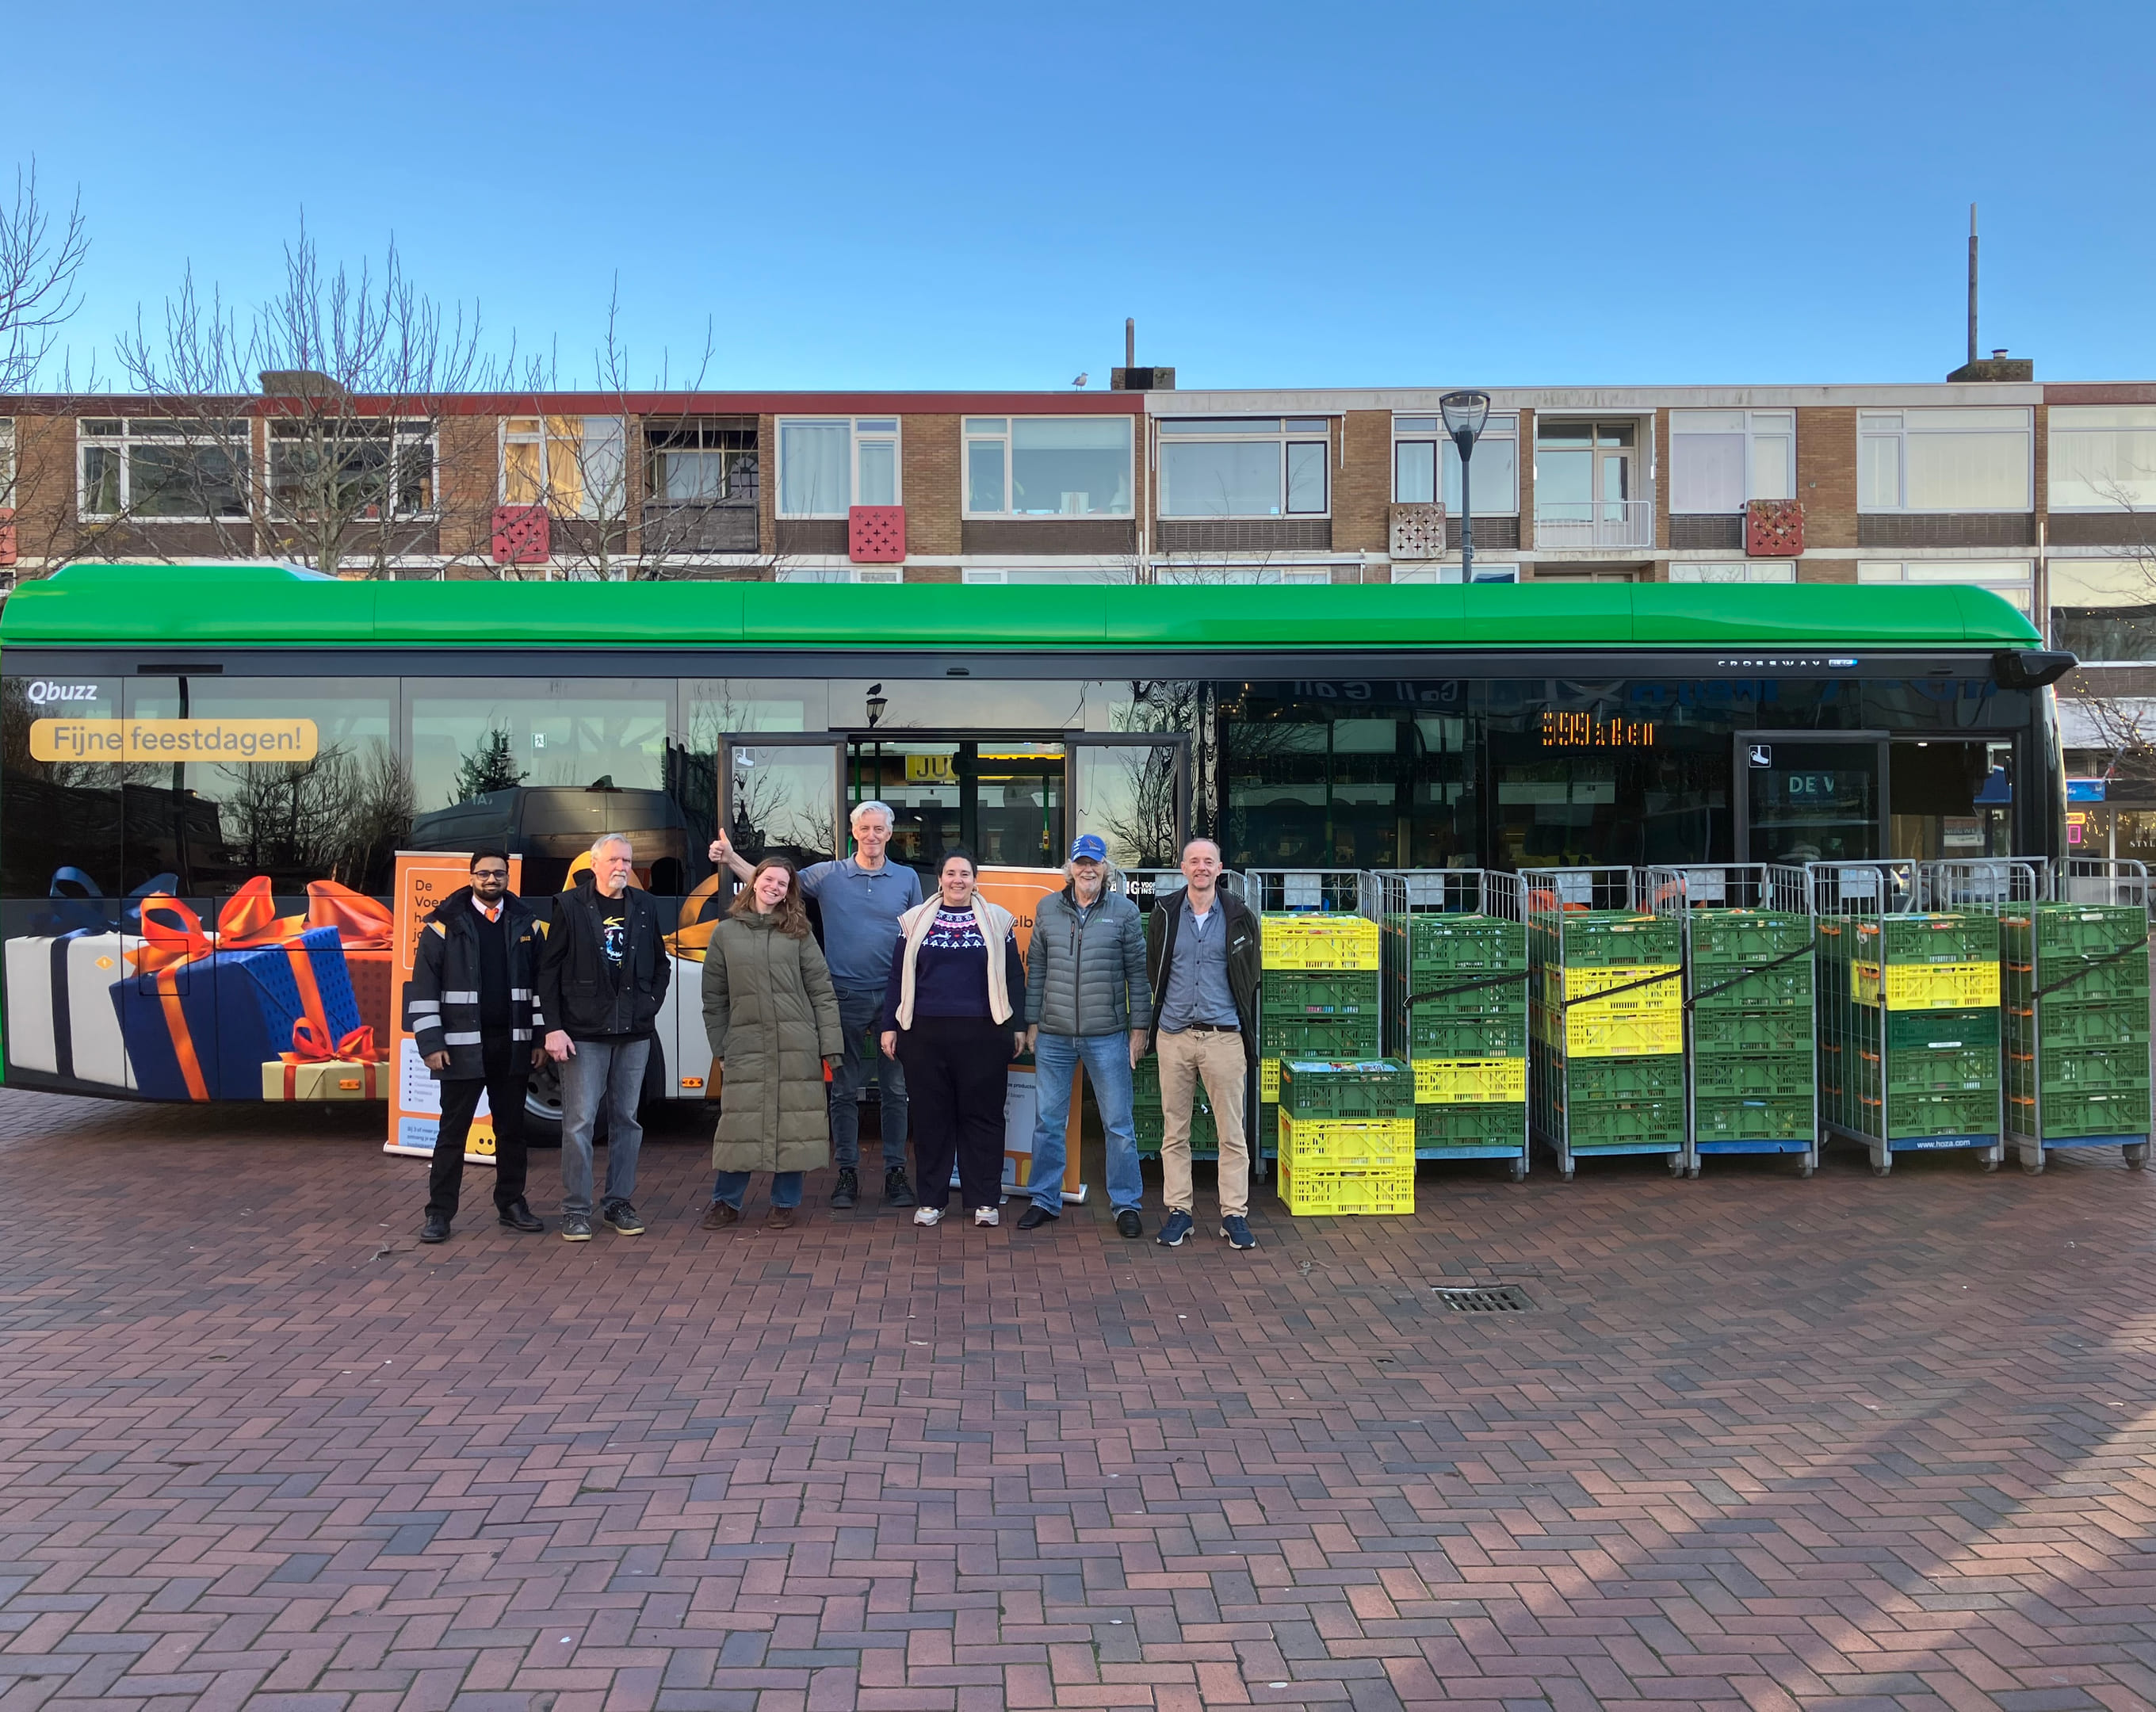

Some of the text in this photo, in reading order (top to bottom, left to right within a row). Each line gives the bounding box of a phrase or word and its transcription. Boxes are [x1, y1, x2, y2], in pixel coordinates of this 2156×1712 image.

[29, 681, 98, 705] Qbuzz
[53, 726, 301, 755] Fijne feestdagen!
[916, 757, 954, 778] JU
[1789, 776, 1834, 793] DE V
[415, 879, 432, 892] De
[415, 896, 439, 908] Voe
[1917, 1140, 1971, 1149] www.hoza.com
